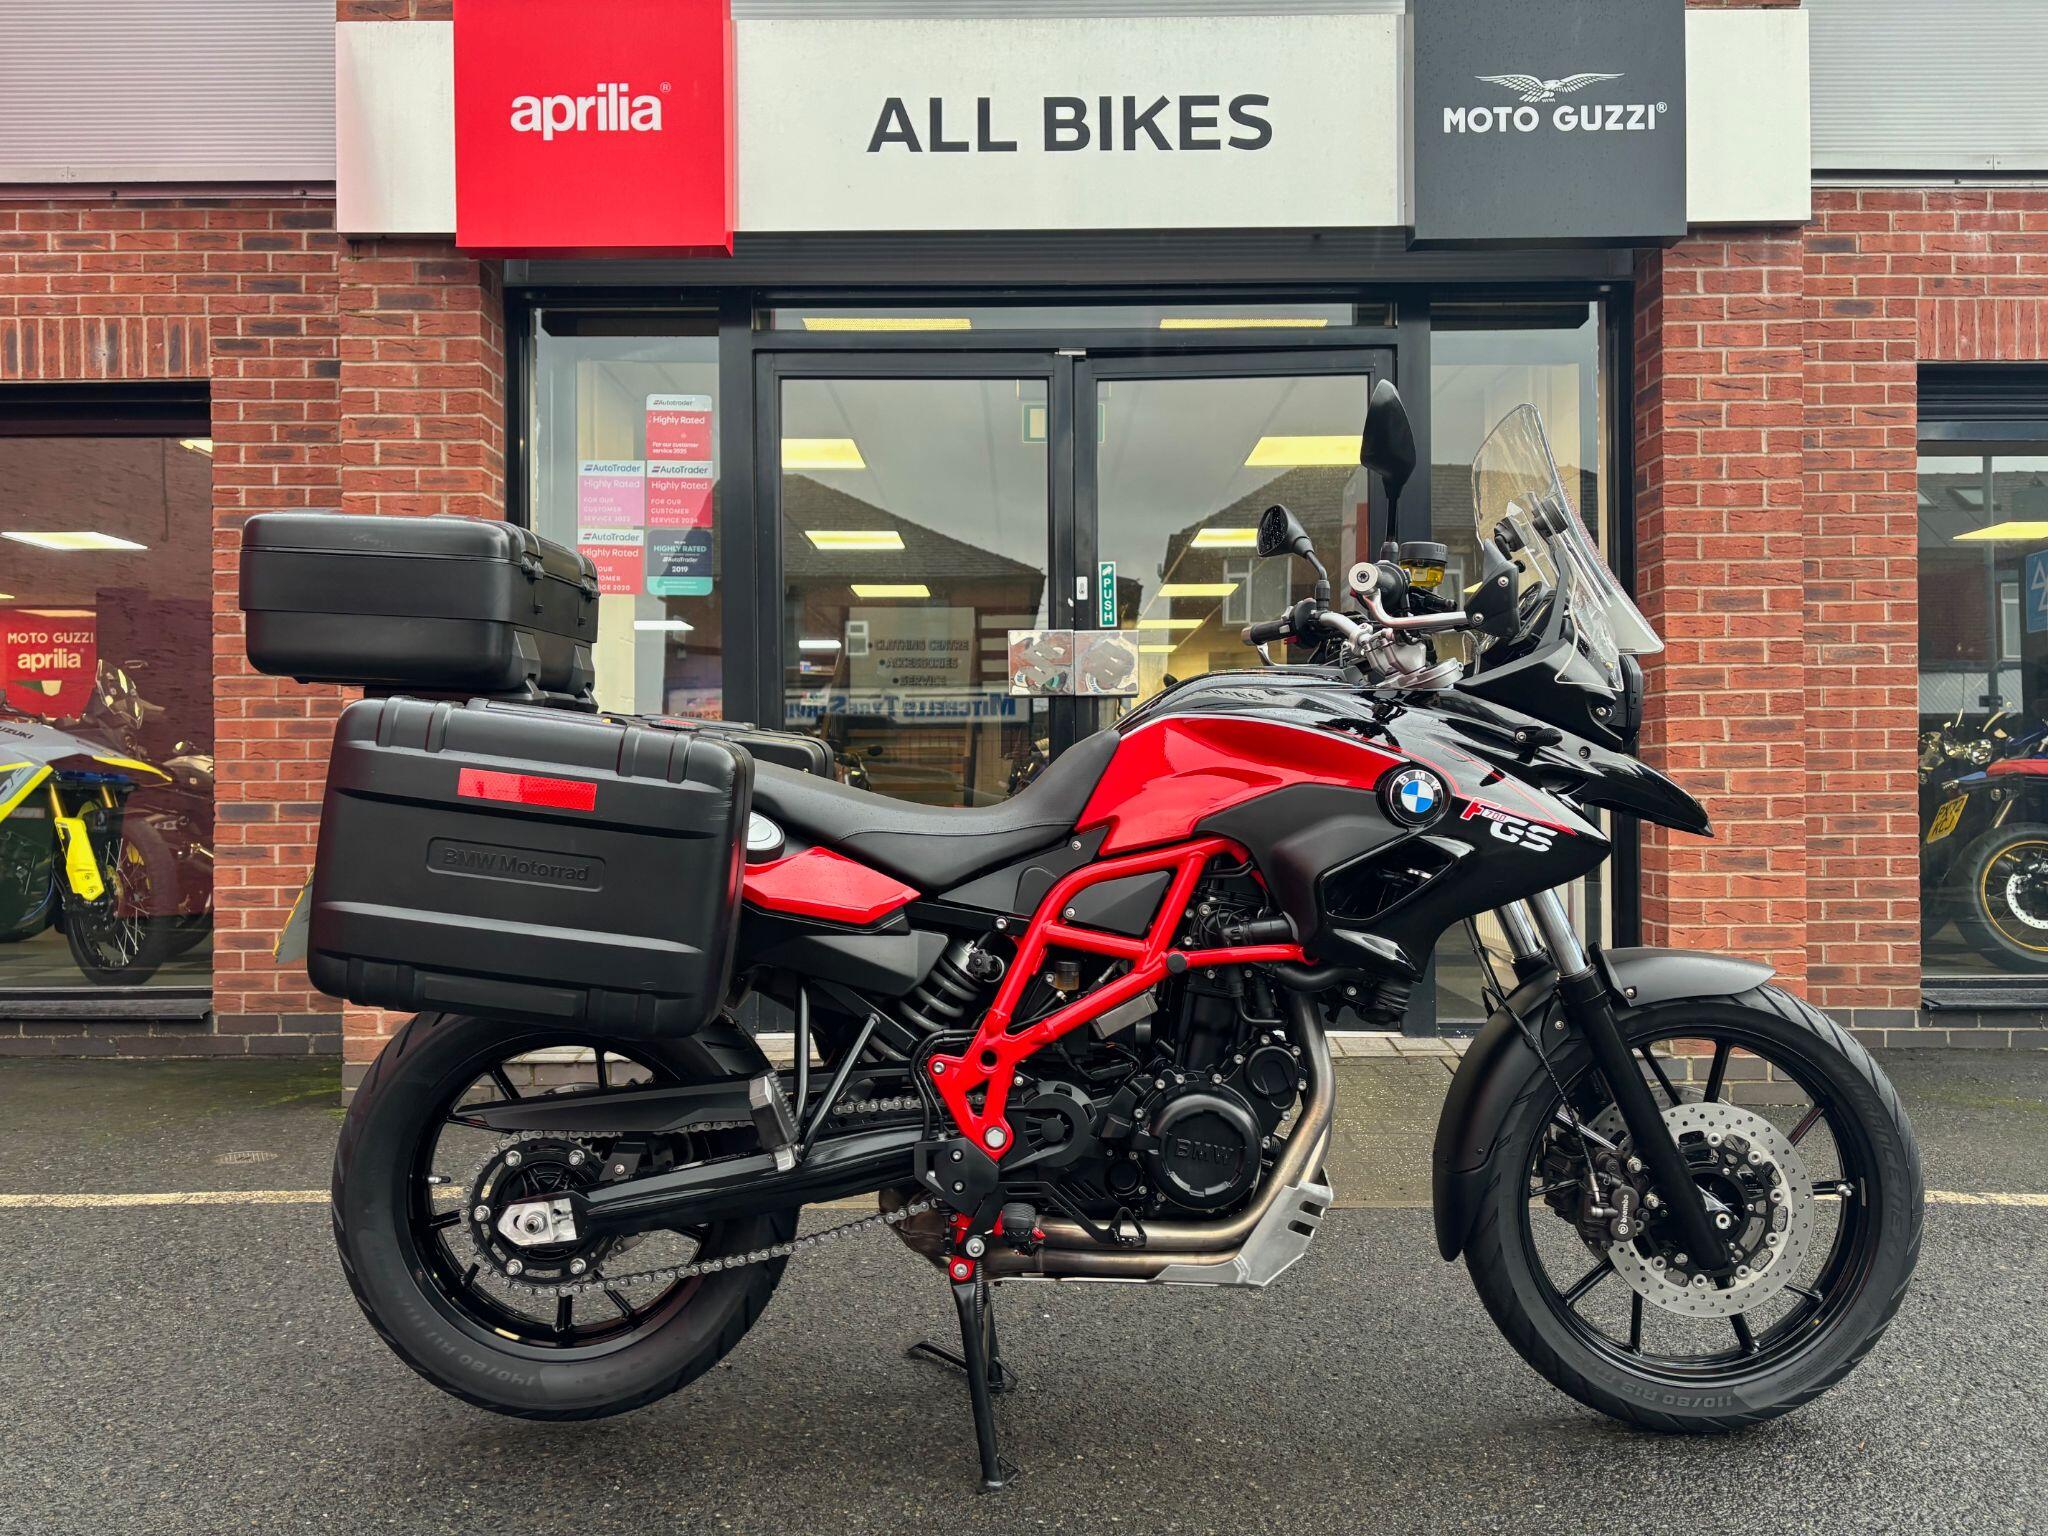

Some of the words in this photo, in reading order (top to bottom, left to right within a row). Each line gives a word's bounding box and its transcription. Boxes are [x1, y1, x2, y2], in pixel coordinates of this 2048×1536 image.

[866, 97, 1018, 153] ALL
[1042, 93, 1273, 152] BIKES
[1443, 105, 1540, 134] MOTO
[652, 415, 680, 426] Highly
[680, 416, 706, 425] Rated
[593, 463, 641, 473] AutoTrader
[660, 465, 709, 474] AutoTrader
[584, 479, 611, 490] Highly
[613, 479, 641, 488] Rated
[651, 481, 681, 491] Highly
[680, 481, 708, 490] Rated
[651, 507, 689, 515] CUSTOMER
[591, 532, 640, 542] AutoTrader
[582, 548, 611, 559] Highly
[612, 548, 639, 558] Rated
[653, 545, 681, 553] HIGHLY
[682, 545, 708, 553] RATED
[671, 565, 689, 573] 2019
[1103, 579, 1114, 622] PUSH
[7, 632, 48, 644] MOTO
[53, 632, 94, 644] GUZZI
[17, 648, 82, 673] aprilia
[1398, 770, 1441, 791] BMW
[1484, 806, 1508, 823] 700
[1489, 817, 1559, 852] GS
[442, 848, 497, 871] BMW
[500, 855, 589, 882] Motorrad
[1176, 1138, 1237, 1165] BMW
[1620, 1194, 1629, 1223] brembo
[458, 1354, 536, 1388] 140/80
